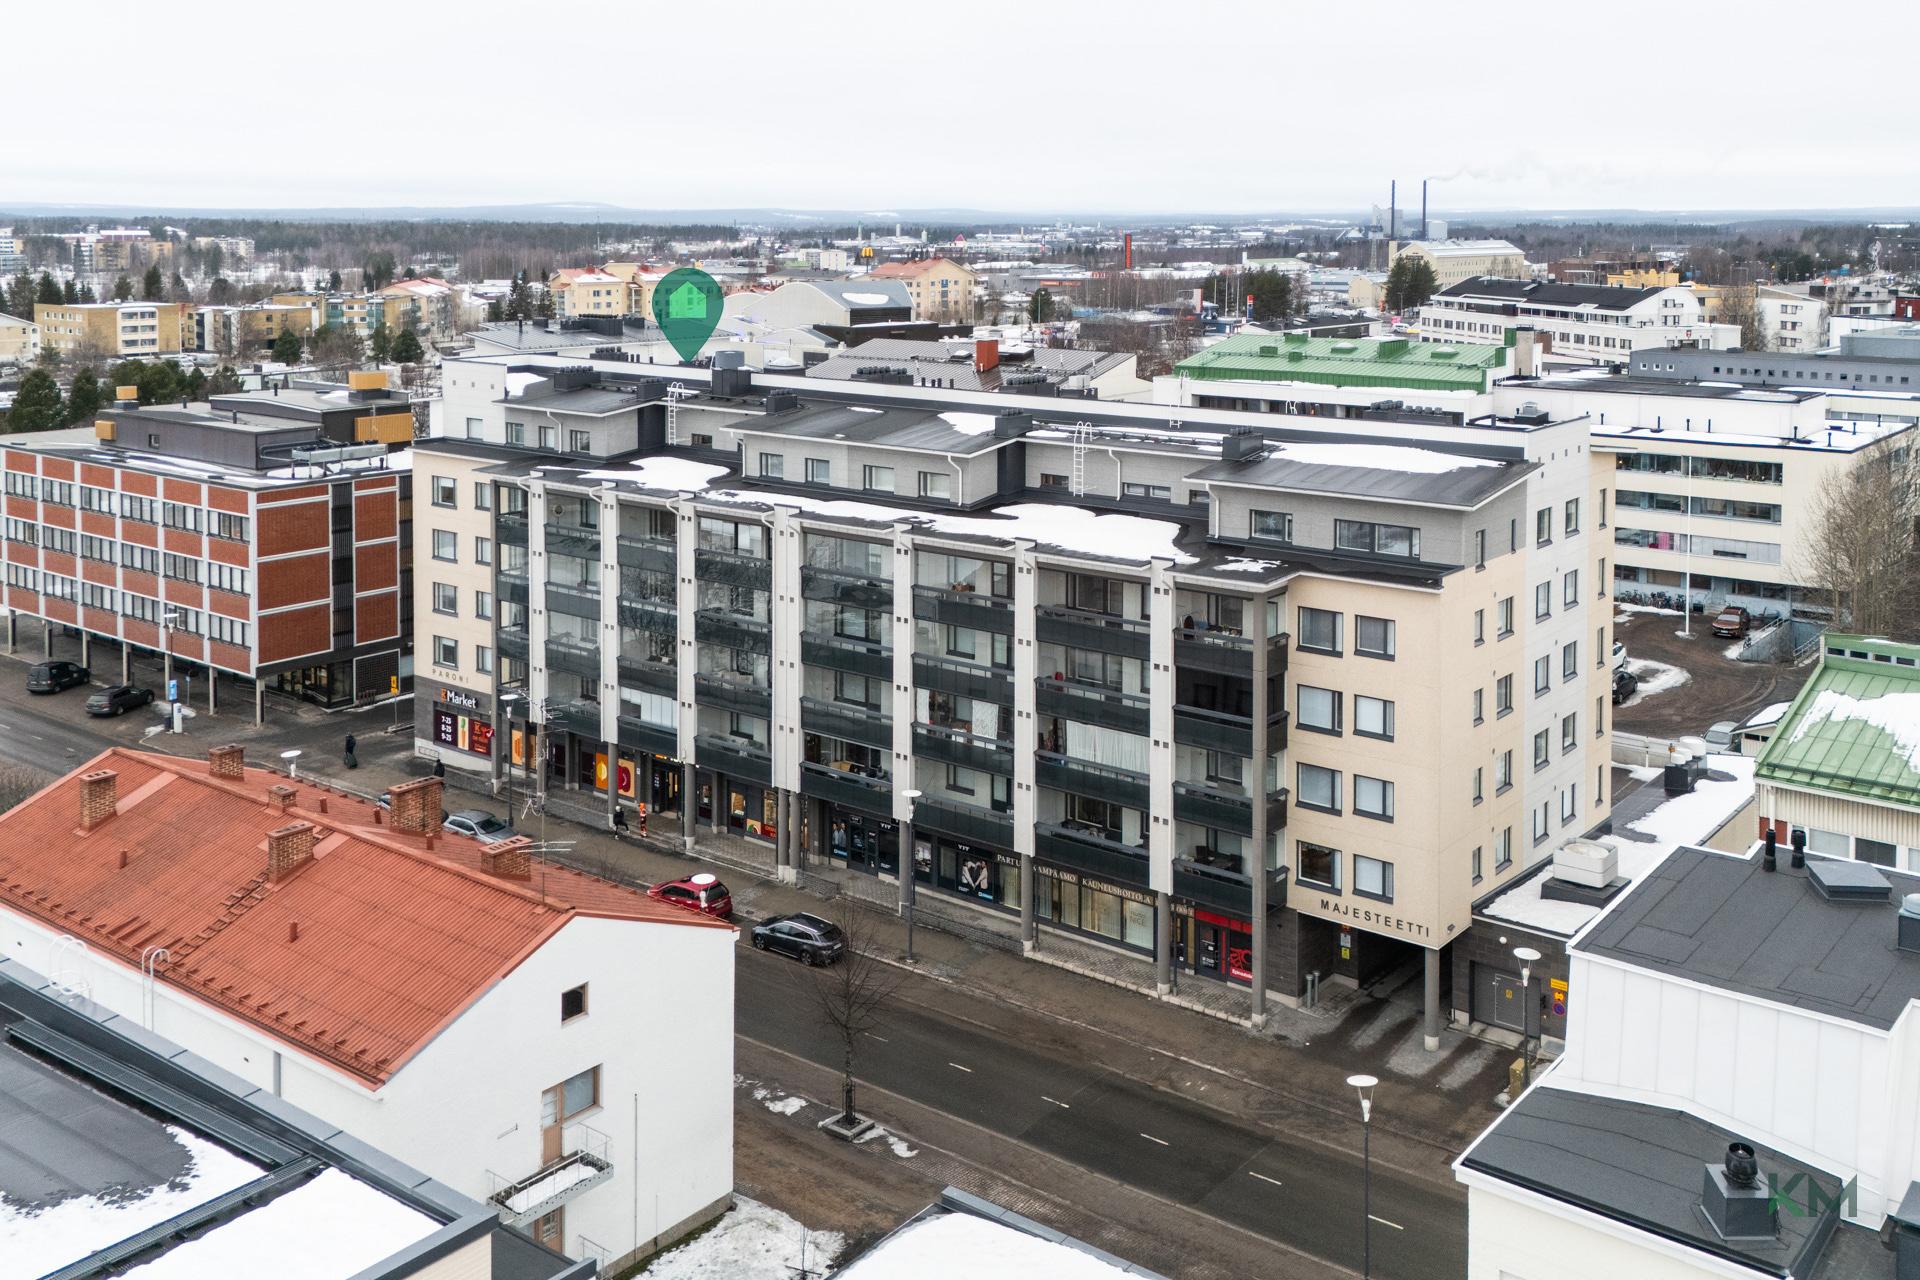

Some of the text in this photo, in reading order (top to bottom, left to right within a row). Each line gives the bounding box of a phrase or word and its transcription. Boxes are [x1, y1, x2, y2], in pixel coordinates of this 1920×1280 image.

[432, 668, 469, 684] PARONI
[997, 854, 1022, 867] PARTU
[1320, 898, 1430, 938] MAJESTEETTI
